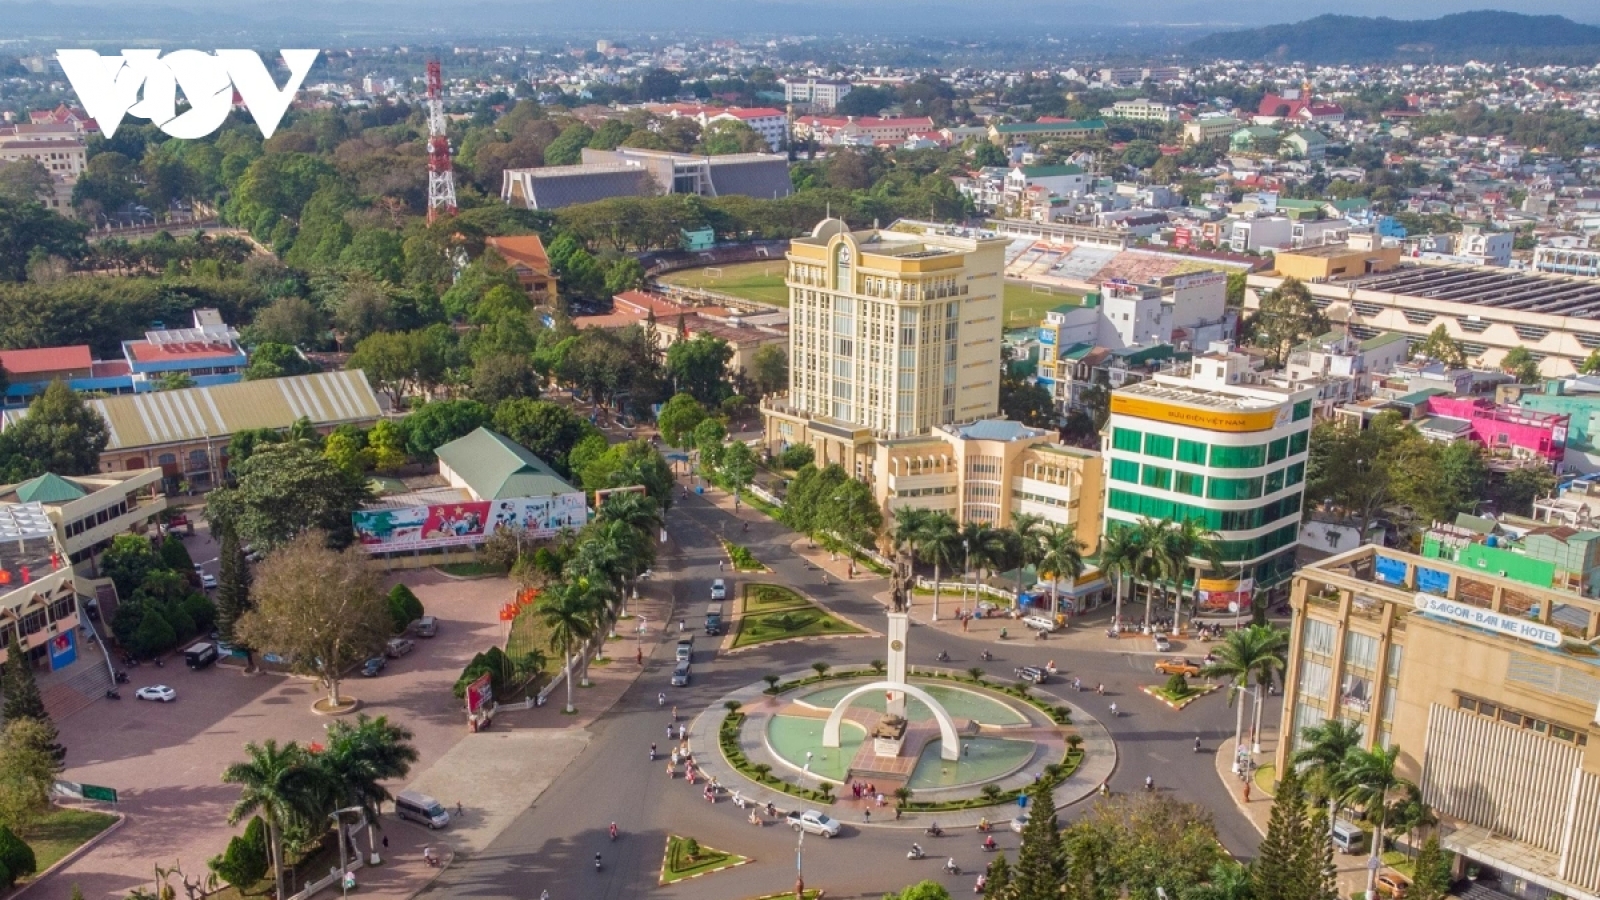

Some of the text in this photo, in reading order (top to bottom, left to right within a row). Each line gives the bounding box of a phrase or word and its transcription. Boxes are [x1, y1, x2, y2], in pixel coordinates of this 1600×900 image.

[1206, 416, 1224, 426] VIỆT
[1430, 599, 1470, 619] SAIGON
[1475, 612, 1498, 626] BAN
[1501, 619, 1518, 632] ME
[1521, 624, 1559, 643] HOTEL
